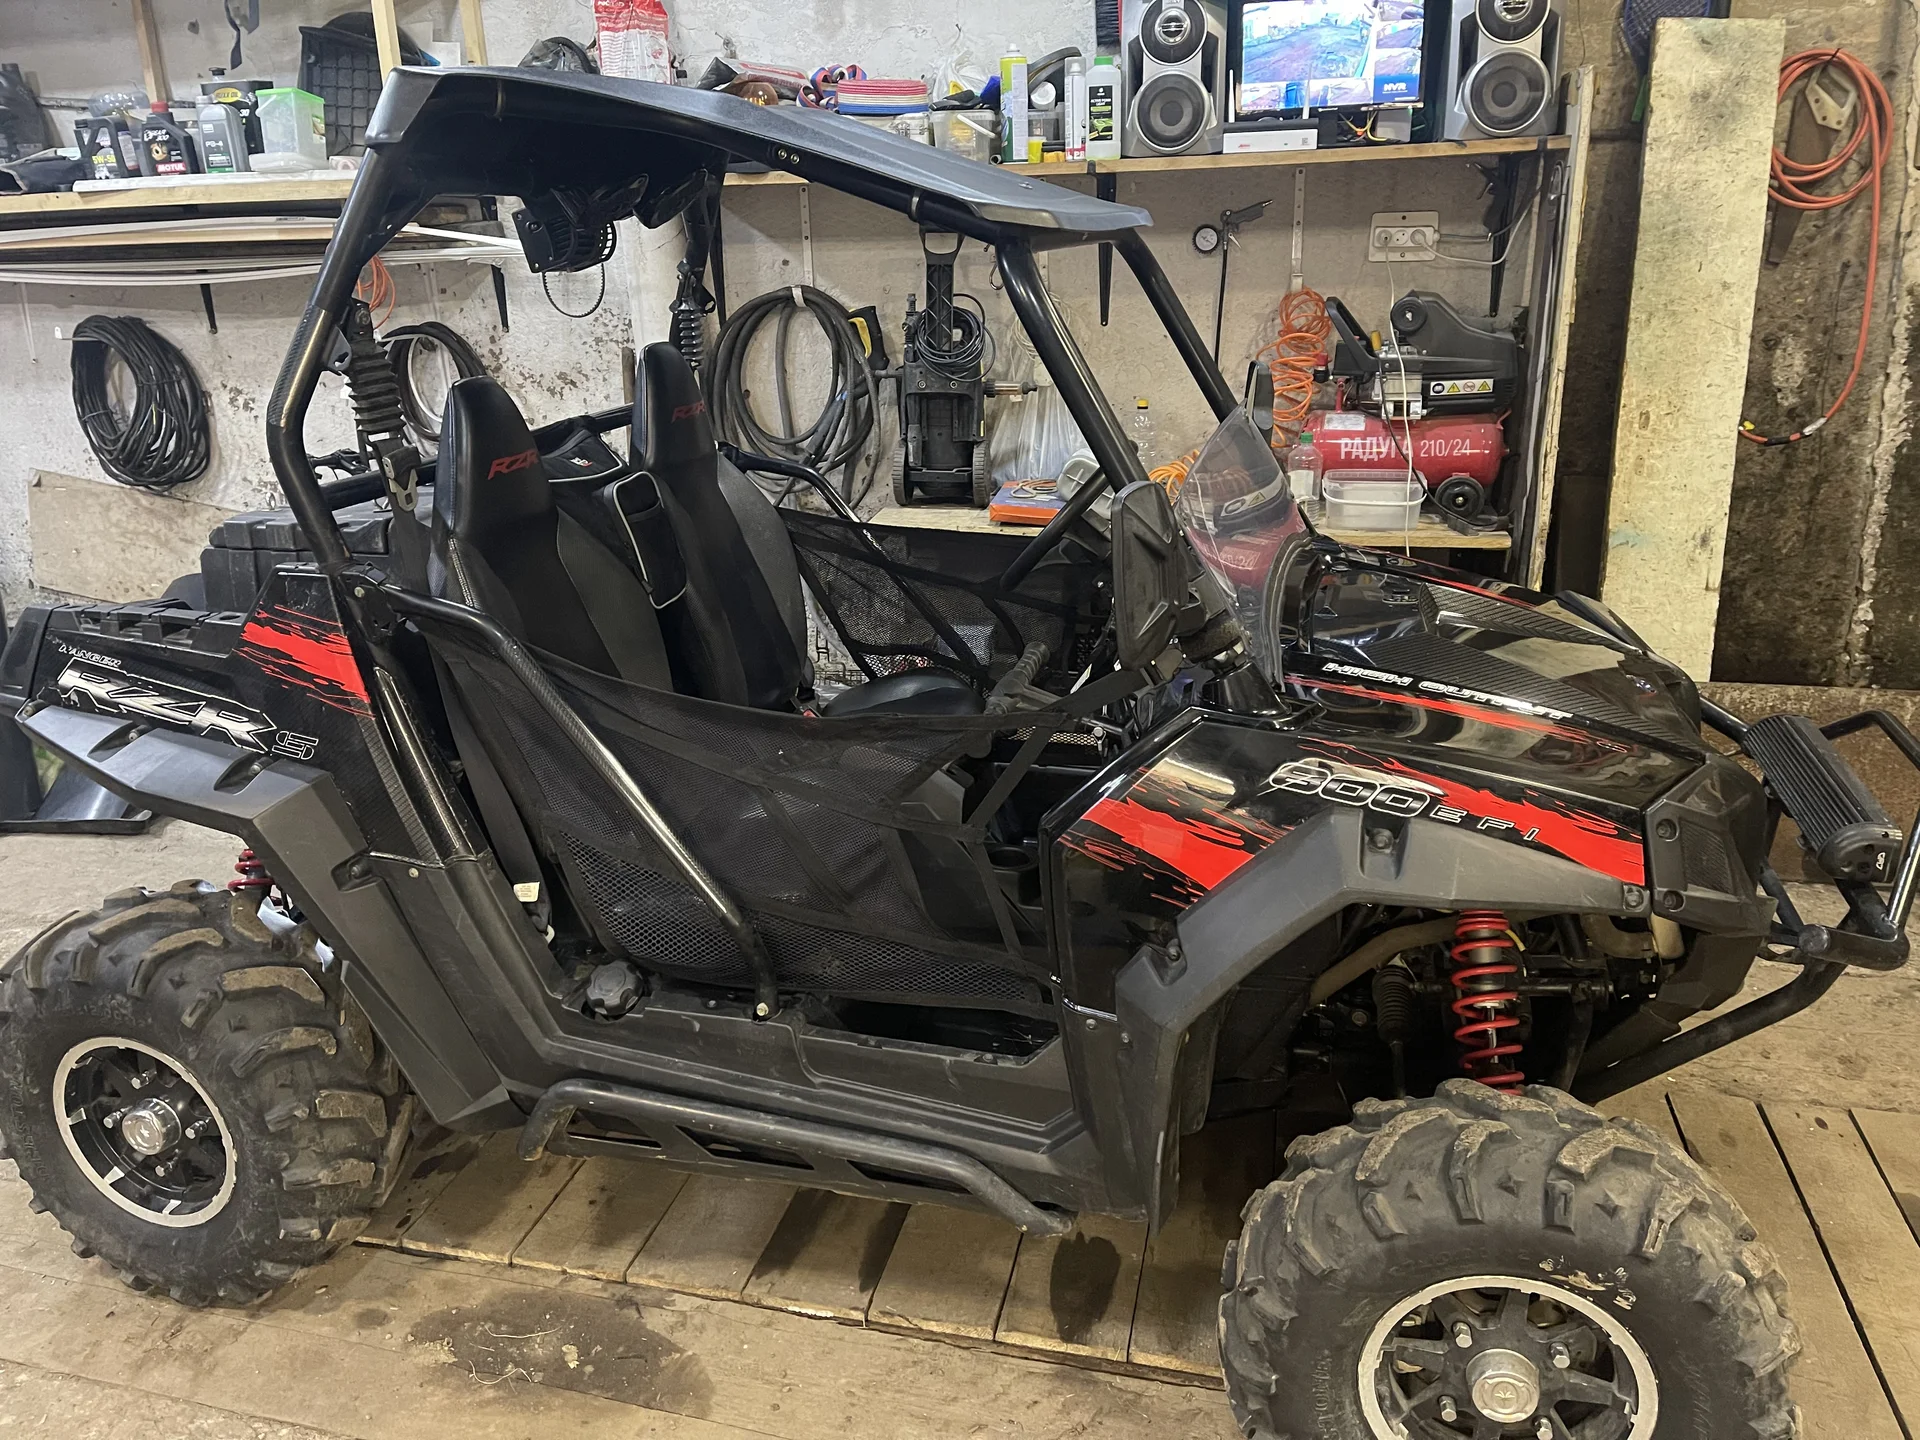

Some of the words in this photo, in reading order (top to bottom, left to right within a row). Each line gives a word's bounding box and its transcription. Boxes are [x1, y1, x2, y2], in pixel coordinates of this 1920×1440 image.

[1383, 82, 1407, 91] NVR
[157, 162, 186, 172] MOTUL
[1340, 436, 1414, 461] РАДУГА
[1420, 439, 1470, 457] 210/24
[487, 449, 539, 481] RZR
[57, 656, 278, 754] RZR
[1323, 662, 1413, 686] HIGH
[1418, 680, 1574, 720] OUTPUT
[1268, 761, 1431, 818] 800
